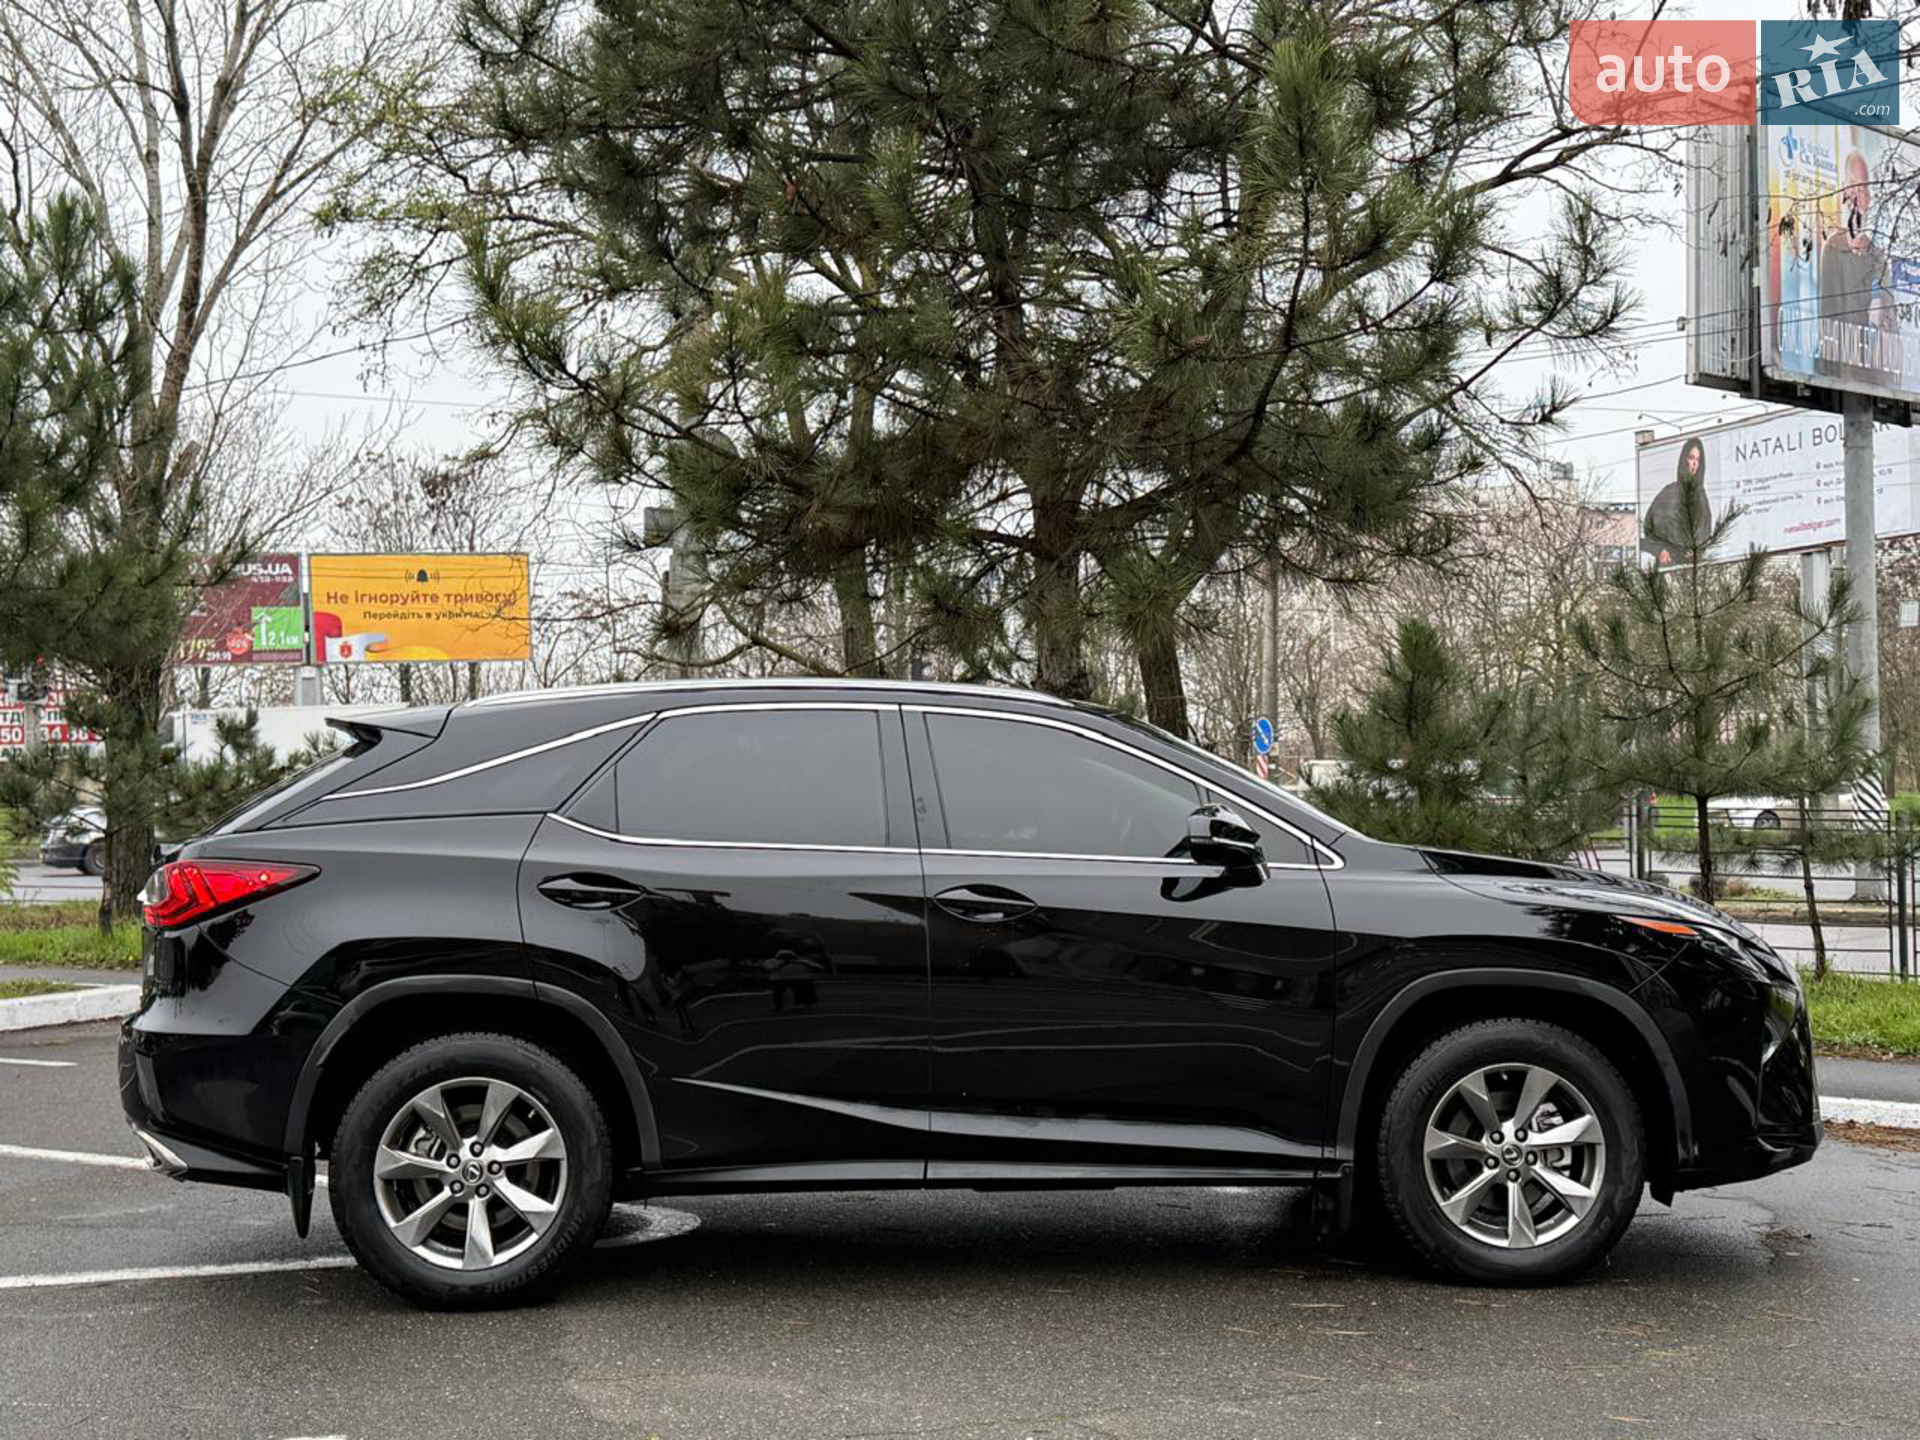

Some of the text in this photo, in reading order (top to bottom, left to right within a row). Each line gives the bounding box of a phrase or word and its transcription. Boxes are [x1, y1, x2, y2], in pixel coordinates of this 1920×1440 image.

[1735, 431, 1802, 462] NATALI
[326, 591, 349, 604] Не
[355, 590, 440, 606] ігноруйте
[363, 610, 423, 621] Перейдіть
[425, 611, 432, 619] в
